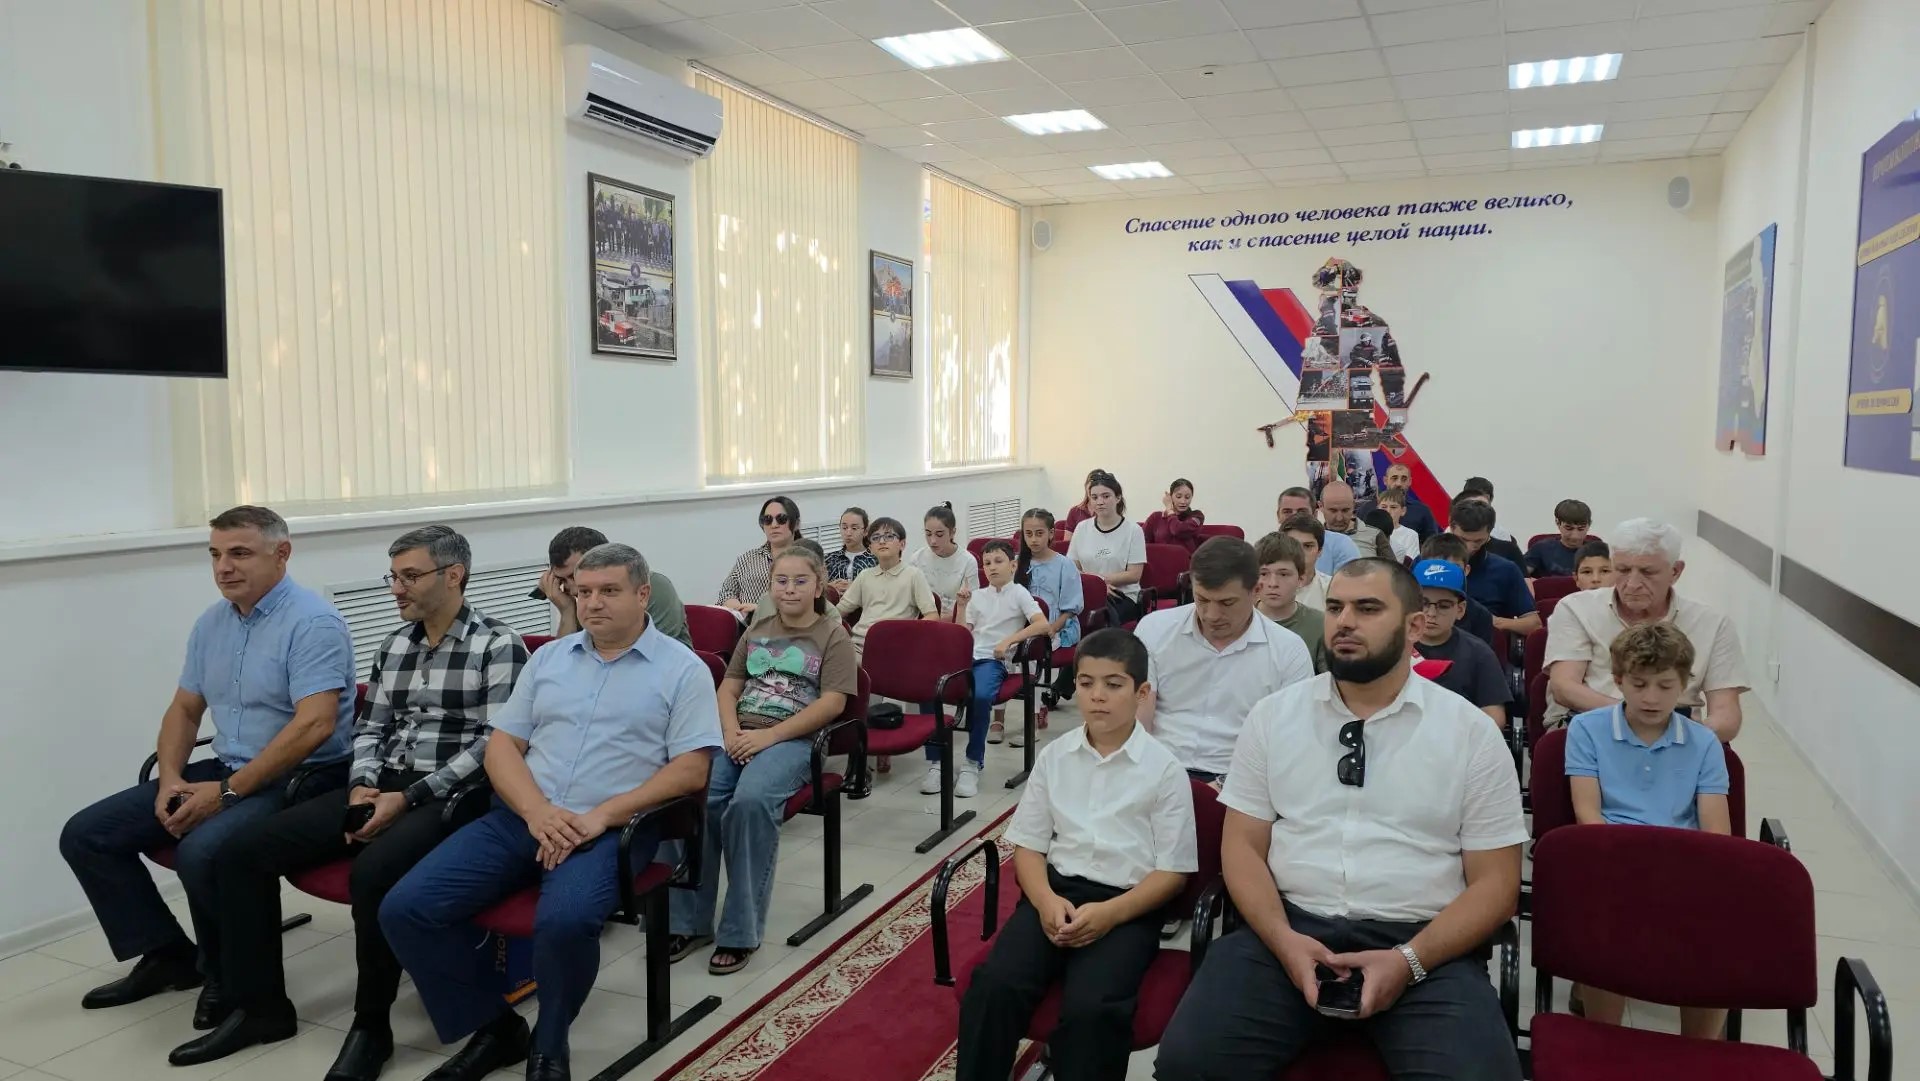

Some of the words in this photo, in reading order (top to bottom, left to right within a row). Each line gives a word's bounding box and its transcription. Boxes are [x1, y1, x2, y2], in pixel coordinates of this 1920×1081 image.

[1125, 217, 1215, 234] Спасение
[1221, 210, 1290, 227] одного
[1295, 204, 1390, 222] человека
[1397, 200, 1478, 216] также
[1485, 193, 1573, 210] велико,
[1188, 238, 1223, 252] как
[1229, 238, 1242, 250] и
[1247, 231, 1340, 249] спасение
[1347, 222, 1410, 247] целой
[1418, 223, 1492, 241] нации.
